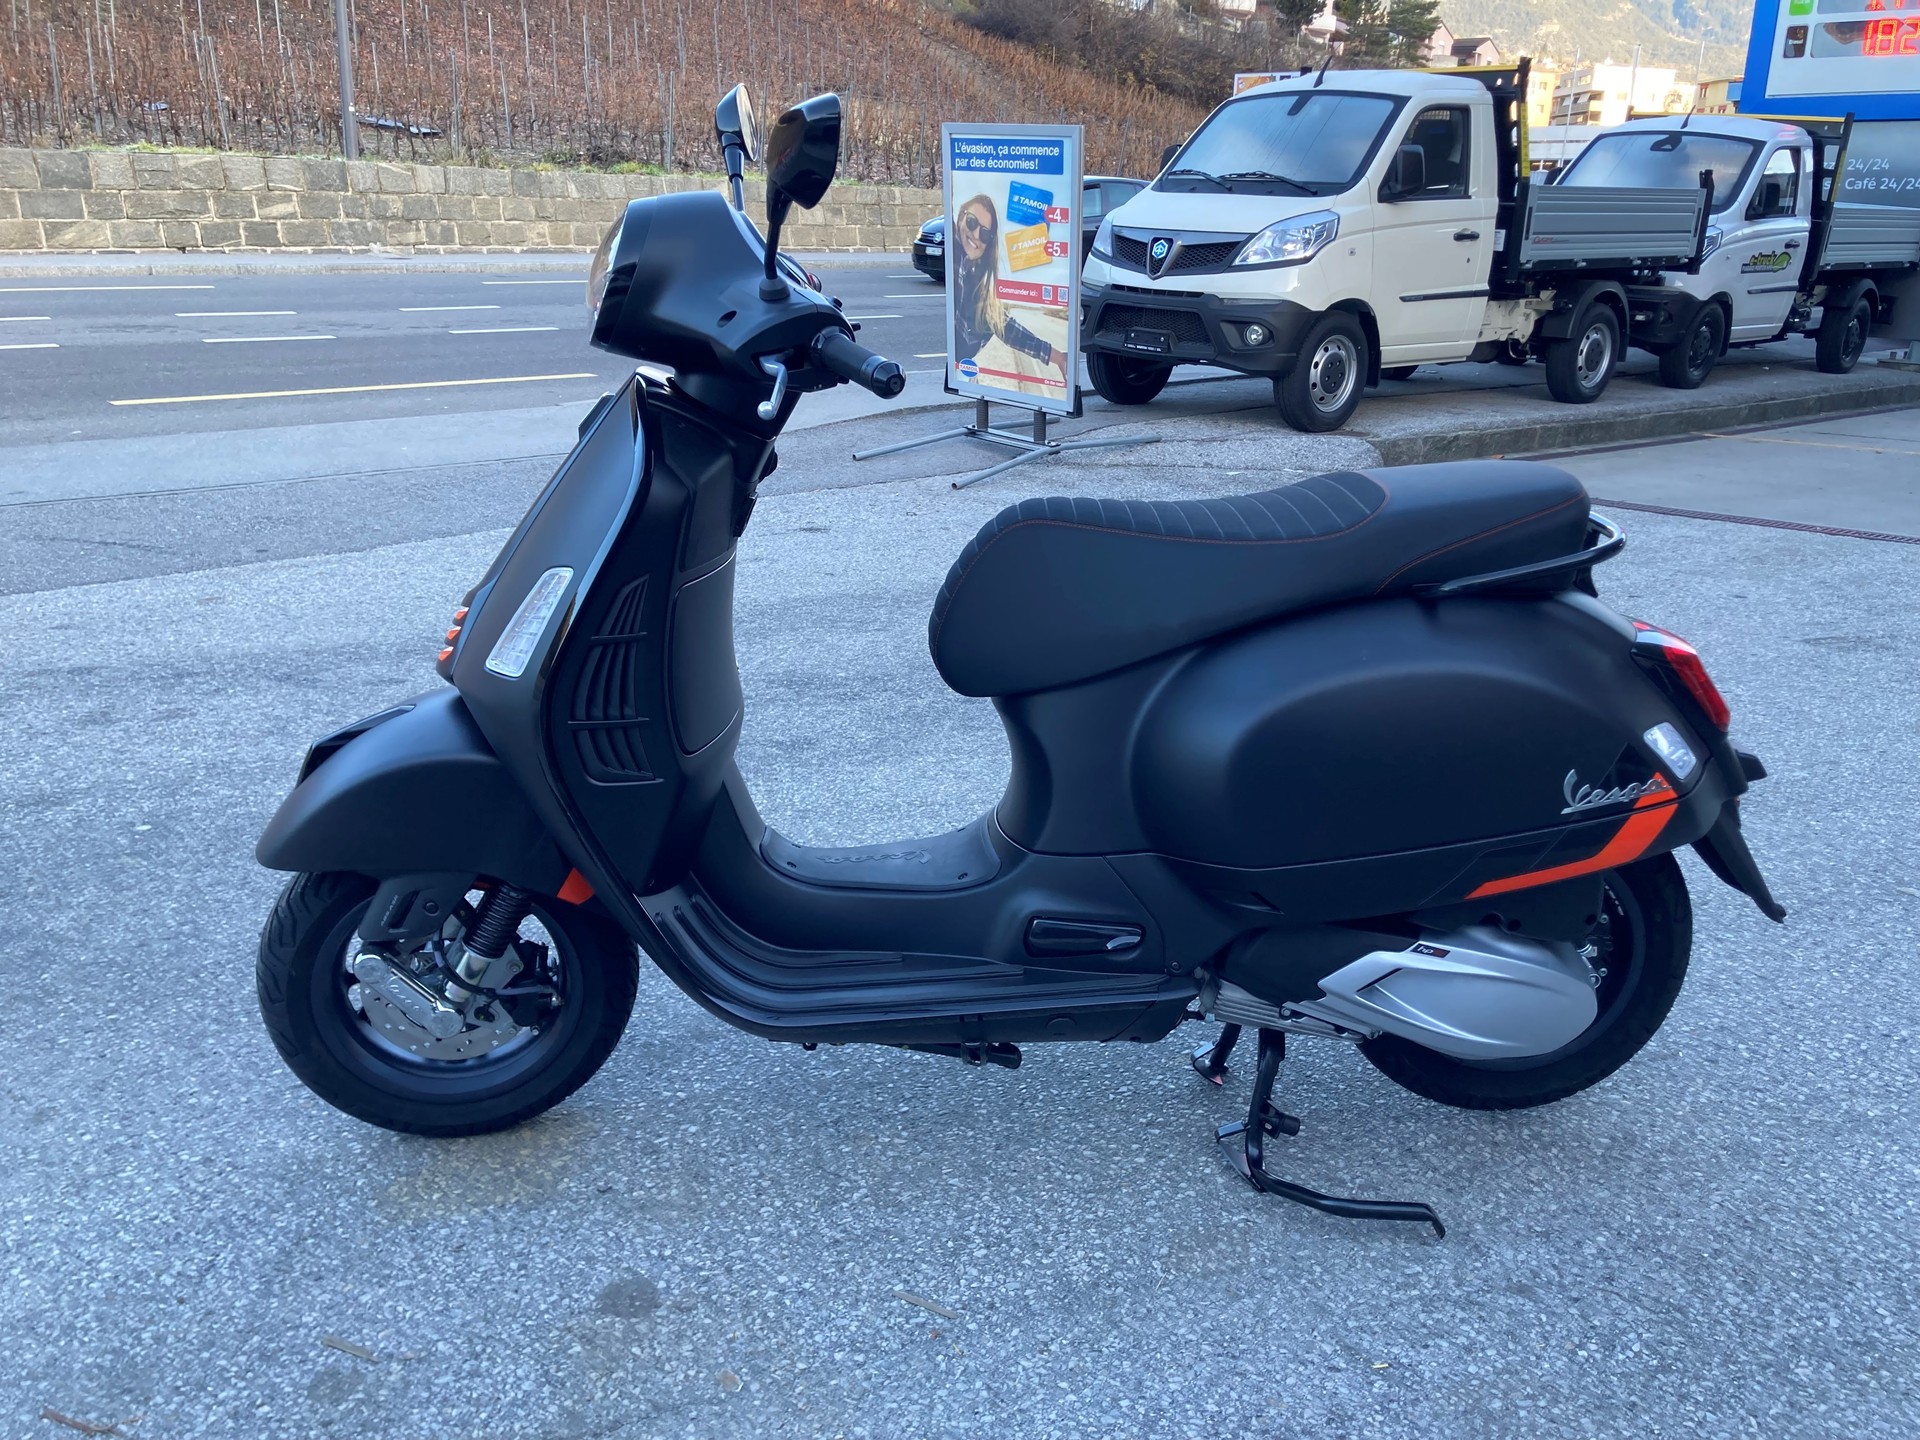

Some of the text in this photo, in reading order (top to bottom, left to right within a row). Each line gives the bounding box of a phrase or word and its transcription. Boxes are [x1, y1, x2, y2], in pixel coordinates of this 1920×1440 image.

[954, 142, 1060, 157] L'évasion, ça commence
[955, 158, 968, 169] par
[970, 156, 986, 168] des
[1846, 158, 1890, 174] 24/24
[1844, 177, 1877, 190] Café
[998, 286, 1029, 296] Commander
[1560, 769, 1672, 814] Vespa
